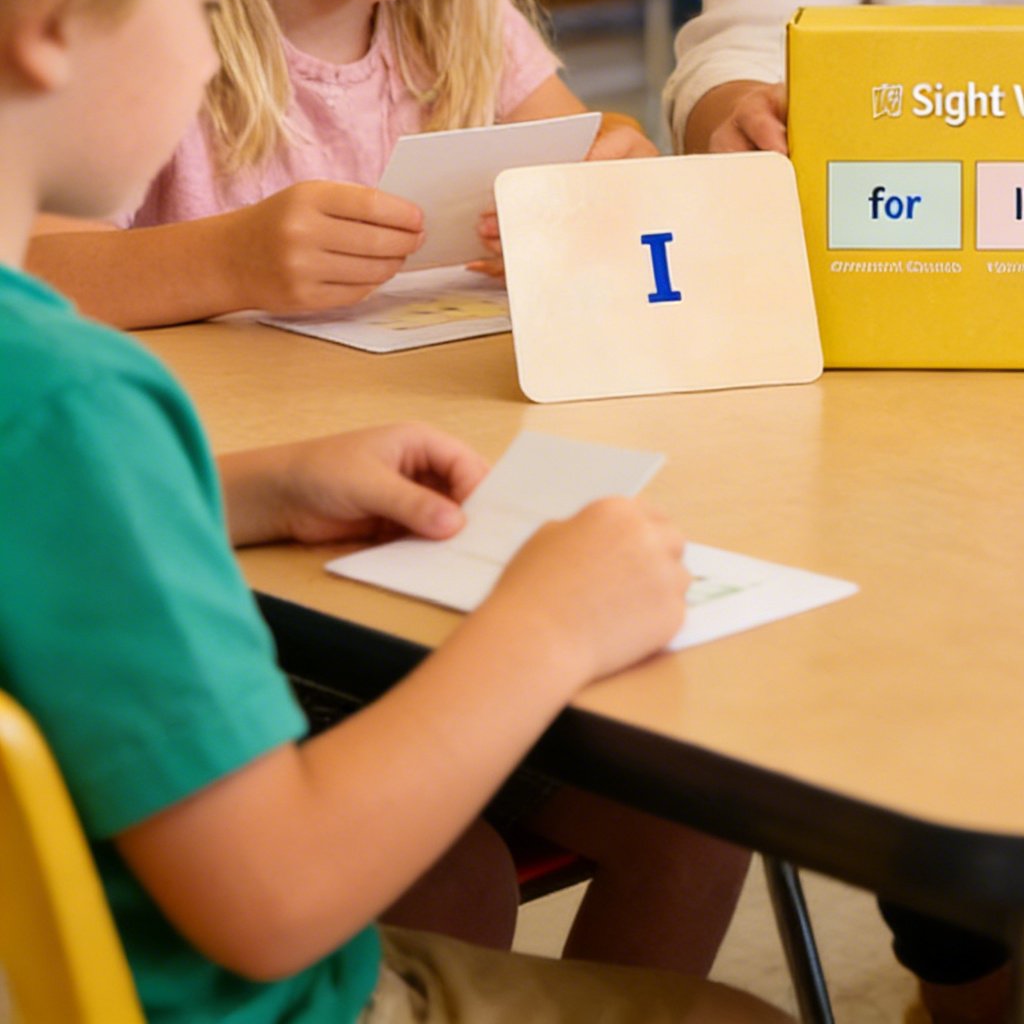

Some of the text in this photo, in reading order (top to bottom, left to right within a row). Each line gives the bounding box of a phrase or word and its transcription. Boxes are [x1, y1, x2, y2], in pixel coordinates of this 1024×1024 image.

[912, 83, 1005, 126] Sight
[869, 187, 922, 220] for
[640, 231, 682, 304] I
